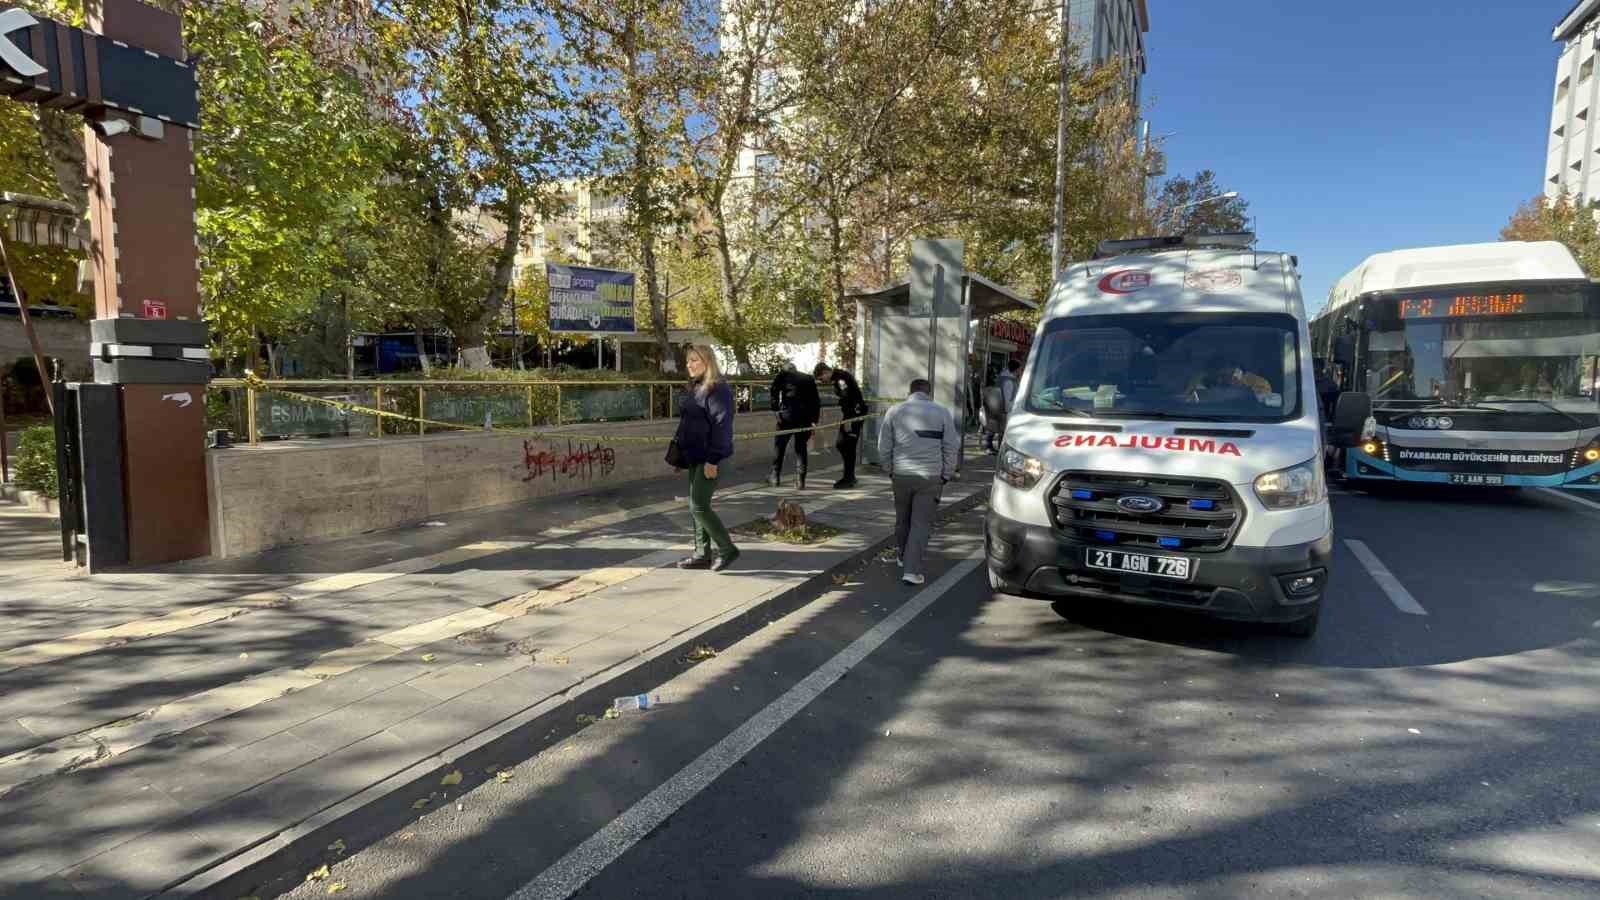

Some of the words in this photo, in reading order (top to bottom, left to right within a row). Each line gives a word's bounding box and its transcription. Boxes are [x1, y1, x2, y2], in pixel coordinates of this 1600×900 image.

[271, 405, 315, 422] ESMA
[1400, 449, 1451, 461] DİYARBAKIR
[1452, 450, 1509, 463] BÜYÜKŞEHİR
[1510, 452, 1563, 464] BELEDİYESİ
[1095, 551, 1113, 568] 21
[1121, 554, 1150, 572] AGN
[1157, 558, 1186, 575] 726
